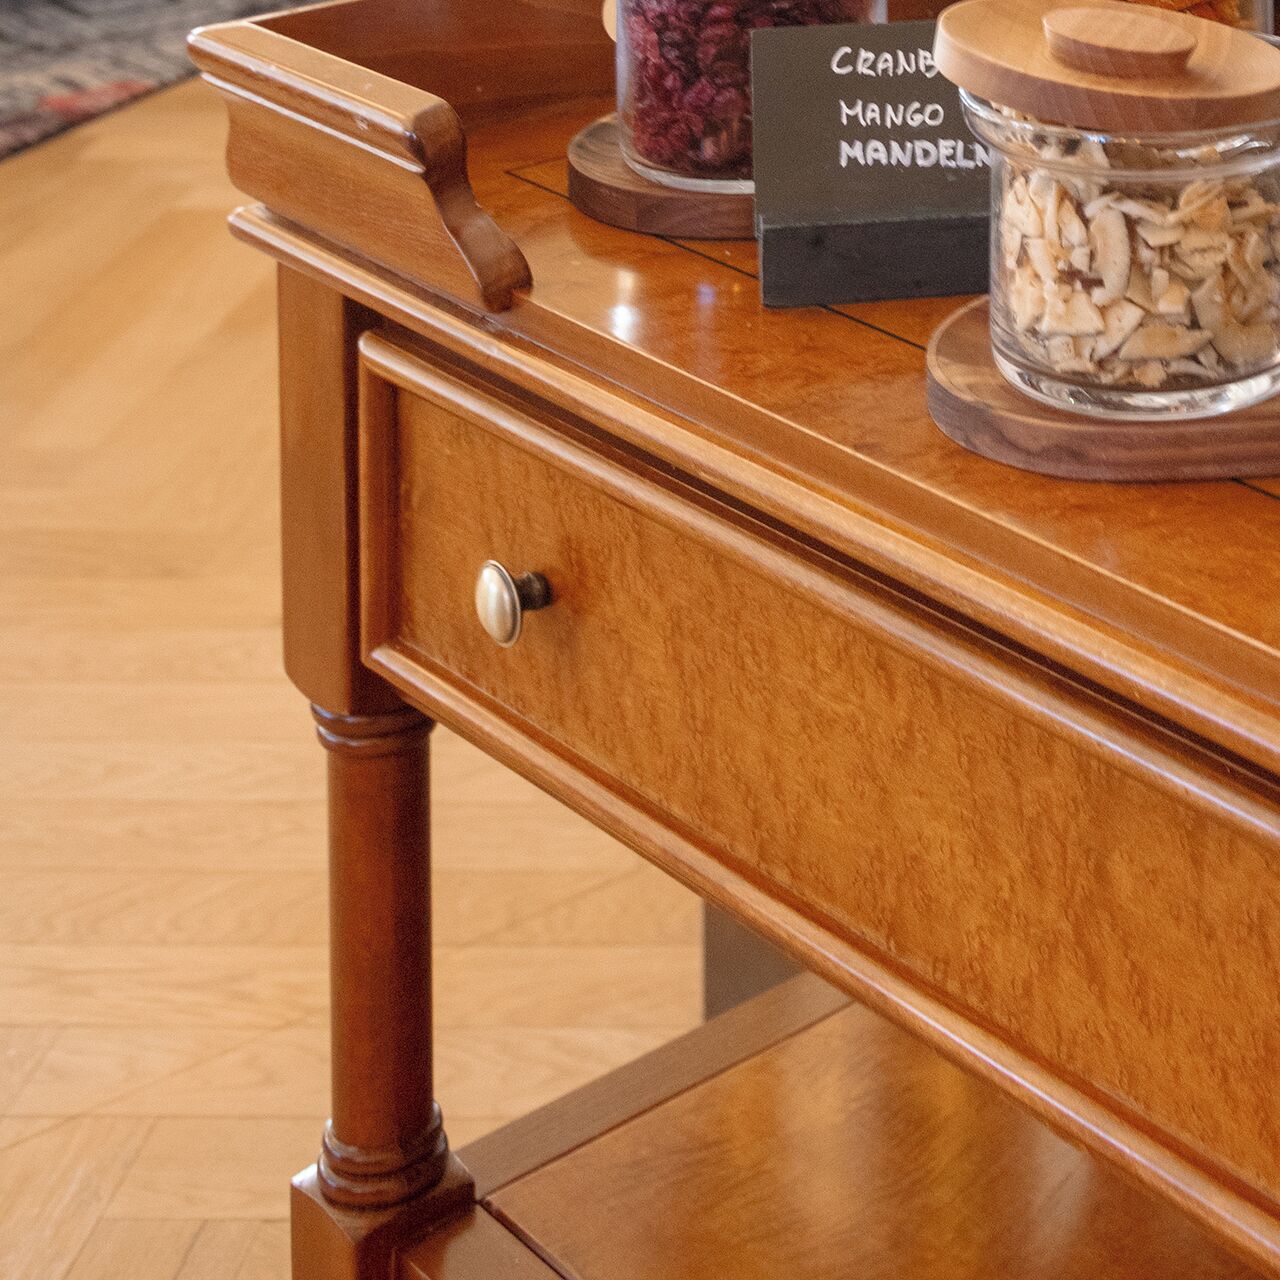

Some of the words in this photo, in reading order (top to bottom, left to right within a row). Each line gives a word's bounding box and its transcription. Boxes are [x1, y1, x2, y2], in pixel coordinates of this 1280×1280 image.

[830, 46, 939, 78] CRANB
[838, 99, 944, 128] MANGO
[838, 138, 993, 169] MANDELN
